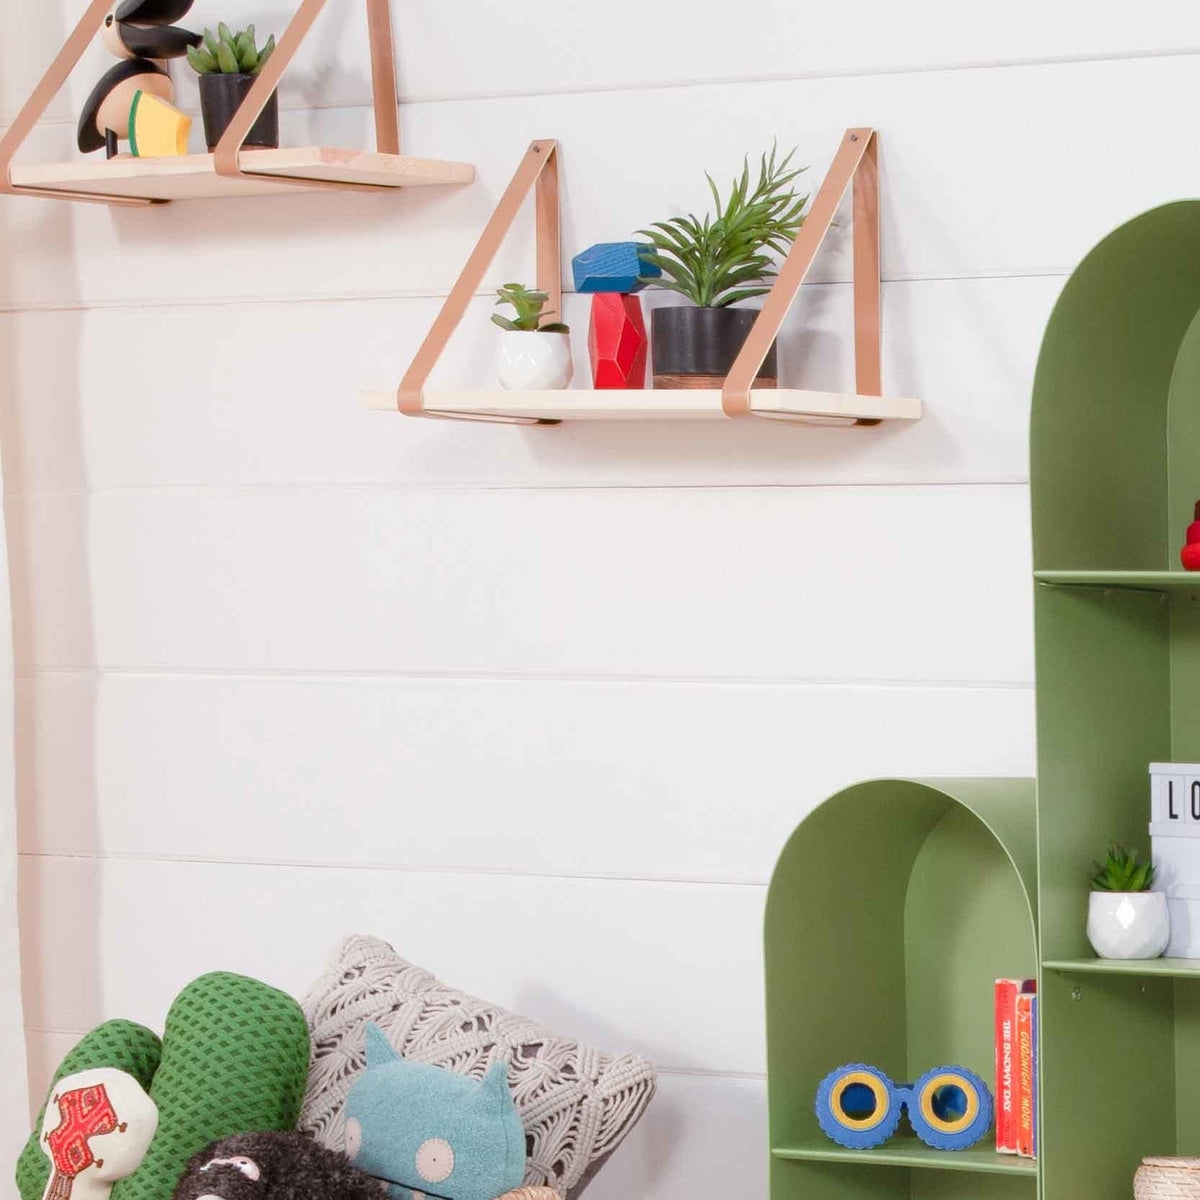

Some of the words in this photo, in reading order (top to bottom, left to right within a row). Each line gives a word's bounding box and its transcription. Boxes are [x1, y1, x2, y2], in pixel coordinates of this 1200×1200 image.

[1003, 1019, 1011, 1041] THE
[1003, 1043, 1012, 1087] SNOWY
[1020, 1031, 1031, 1094] GOODNIGHT
[1003, 1088, 1012, 1113] DAY
[1022, 1097, 1031, 1130] MOON
